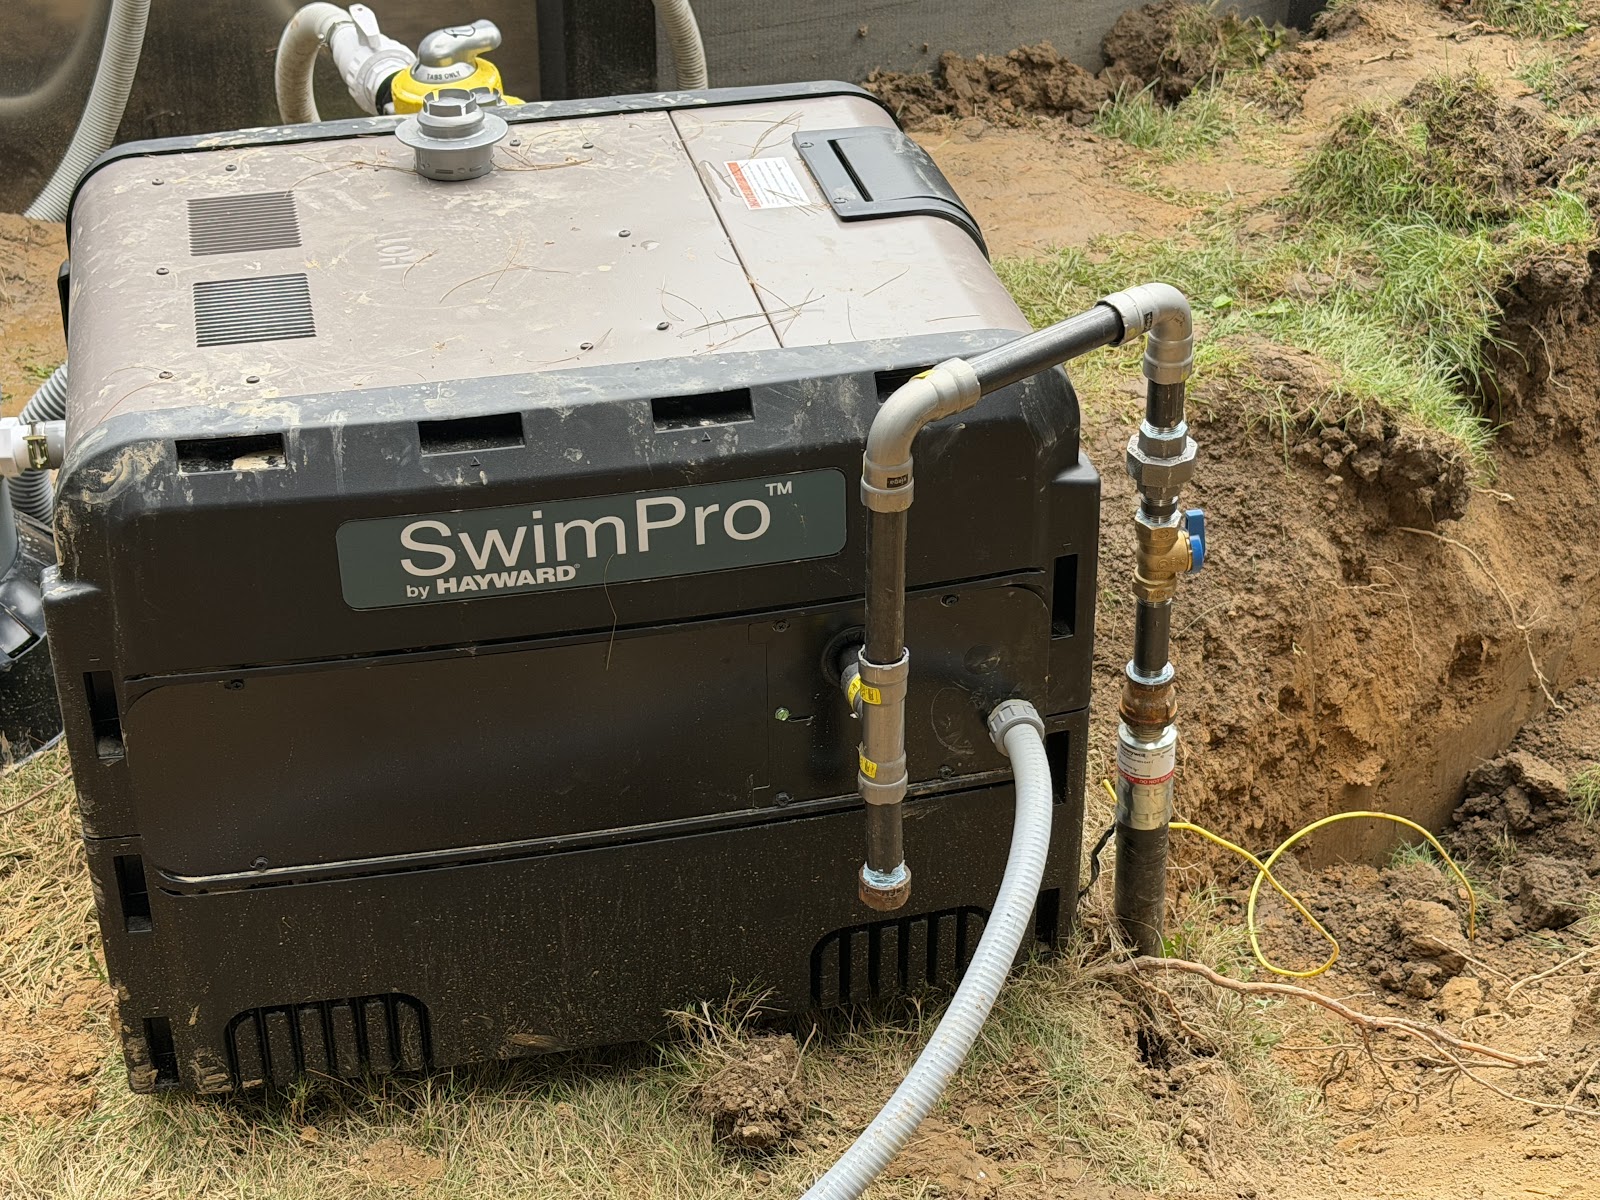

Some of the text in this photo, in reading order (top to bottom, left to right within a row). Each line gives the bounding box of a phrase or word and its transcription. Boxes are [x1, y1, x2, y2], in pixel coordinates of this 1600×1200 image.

[426, 73, 443, 81] TABS
[400, 496, 771, 577] SwimPro
[406, 565, 576, 600] by HAYWARD
